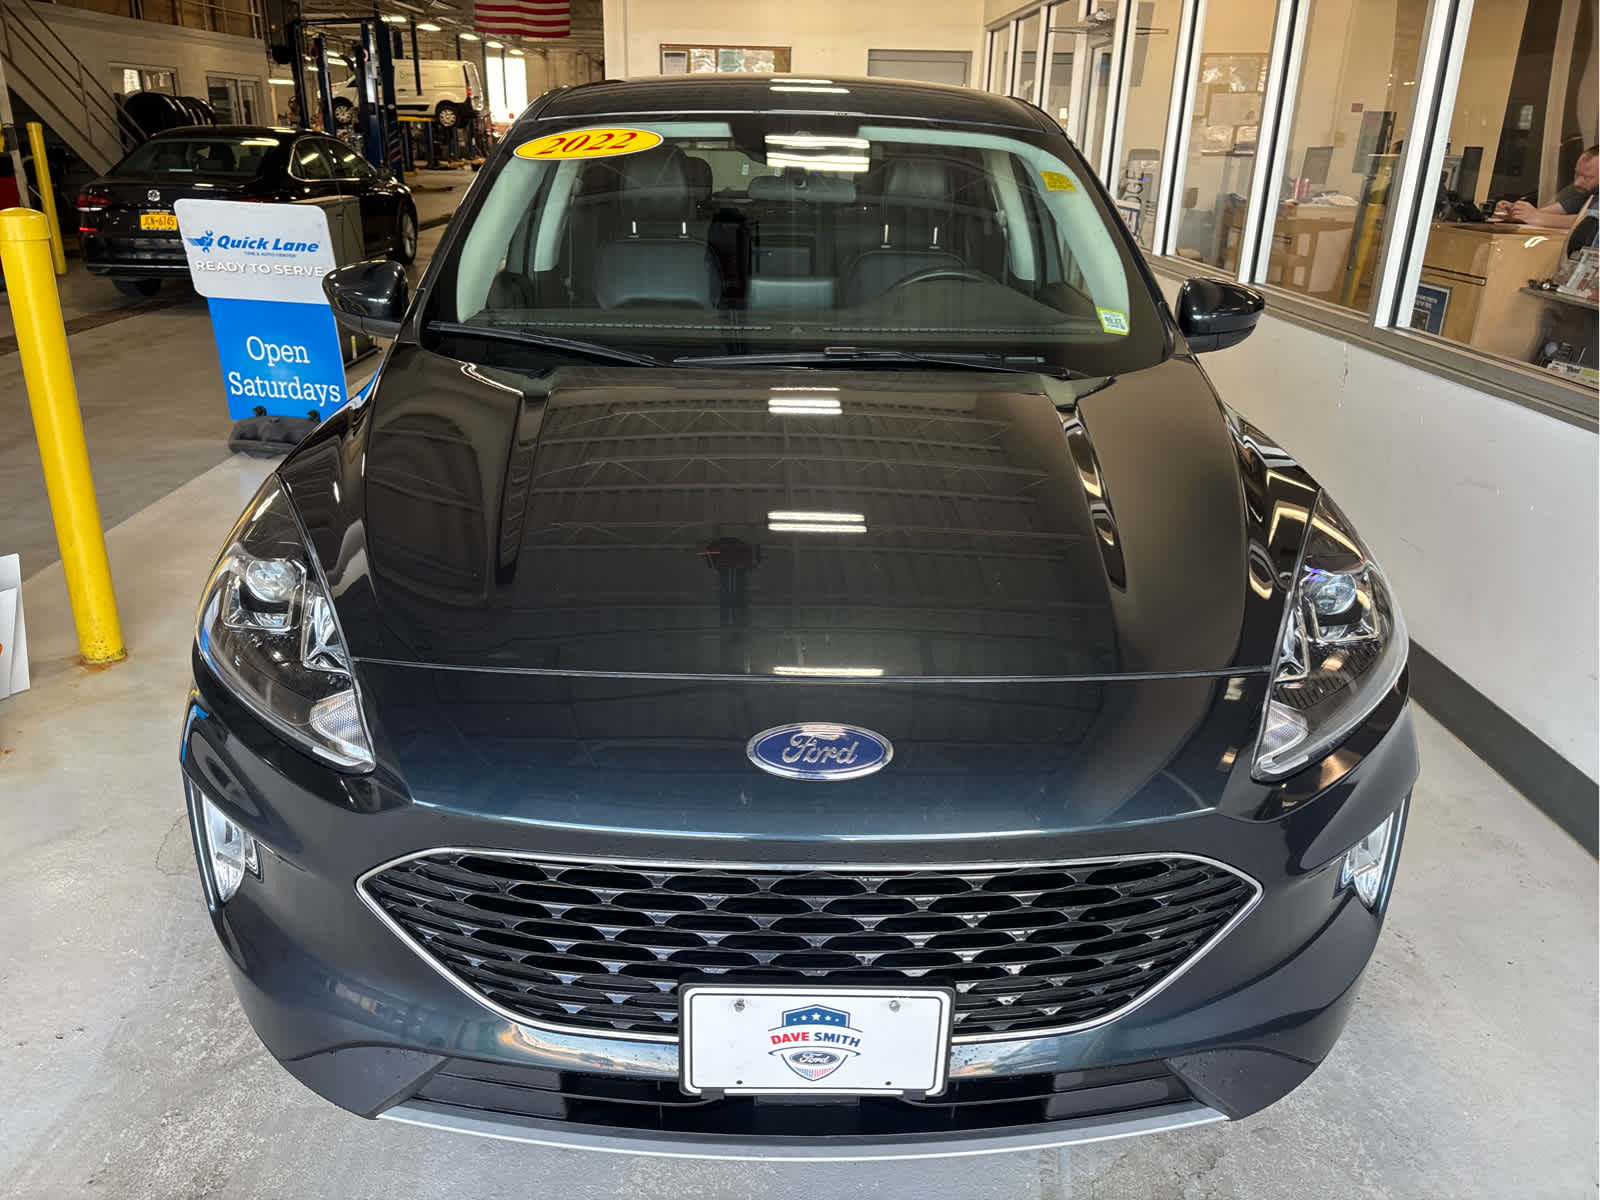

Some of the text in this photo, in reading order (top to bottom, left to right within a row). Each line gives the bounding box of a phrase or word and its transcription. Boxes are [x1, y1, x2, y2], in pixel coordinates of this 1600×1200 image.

[534, 132, 638, 156] 2022
[217, 234, 319, 253] Quick Lane
[195, 260, 325, 278] READY TO SERVE
[246, 336, 310, 366] Open
[228, 371, 341, 407] Saturdays
[782, 732, 860, 764] Ford
[770, 1031, 861, 1048] DAVE SMITH
[800, 1052, 831, 1064] Ford
